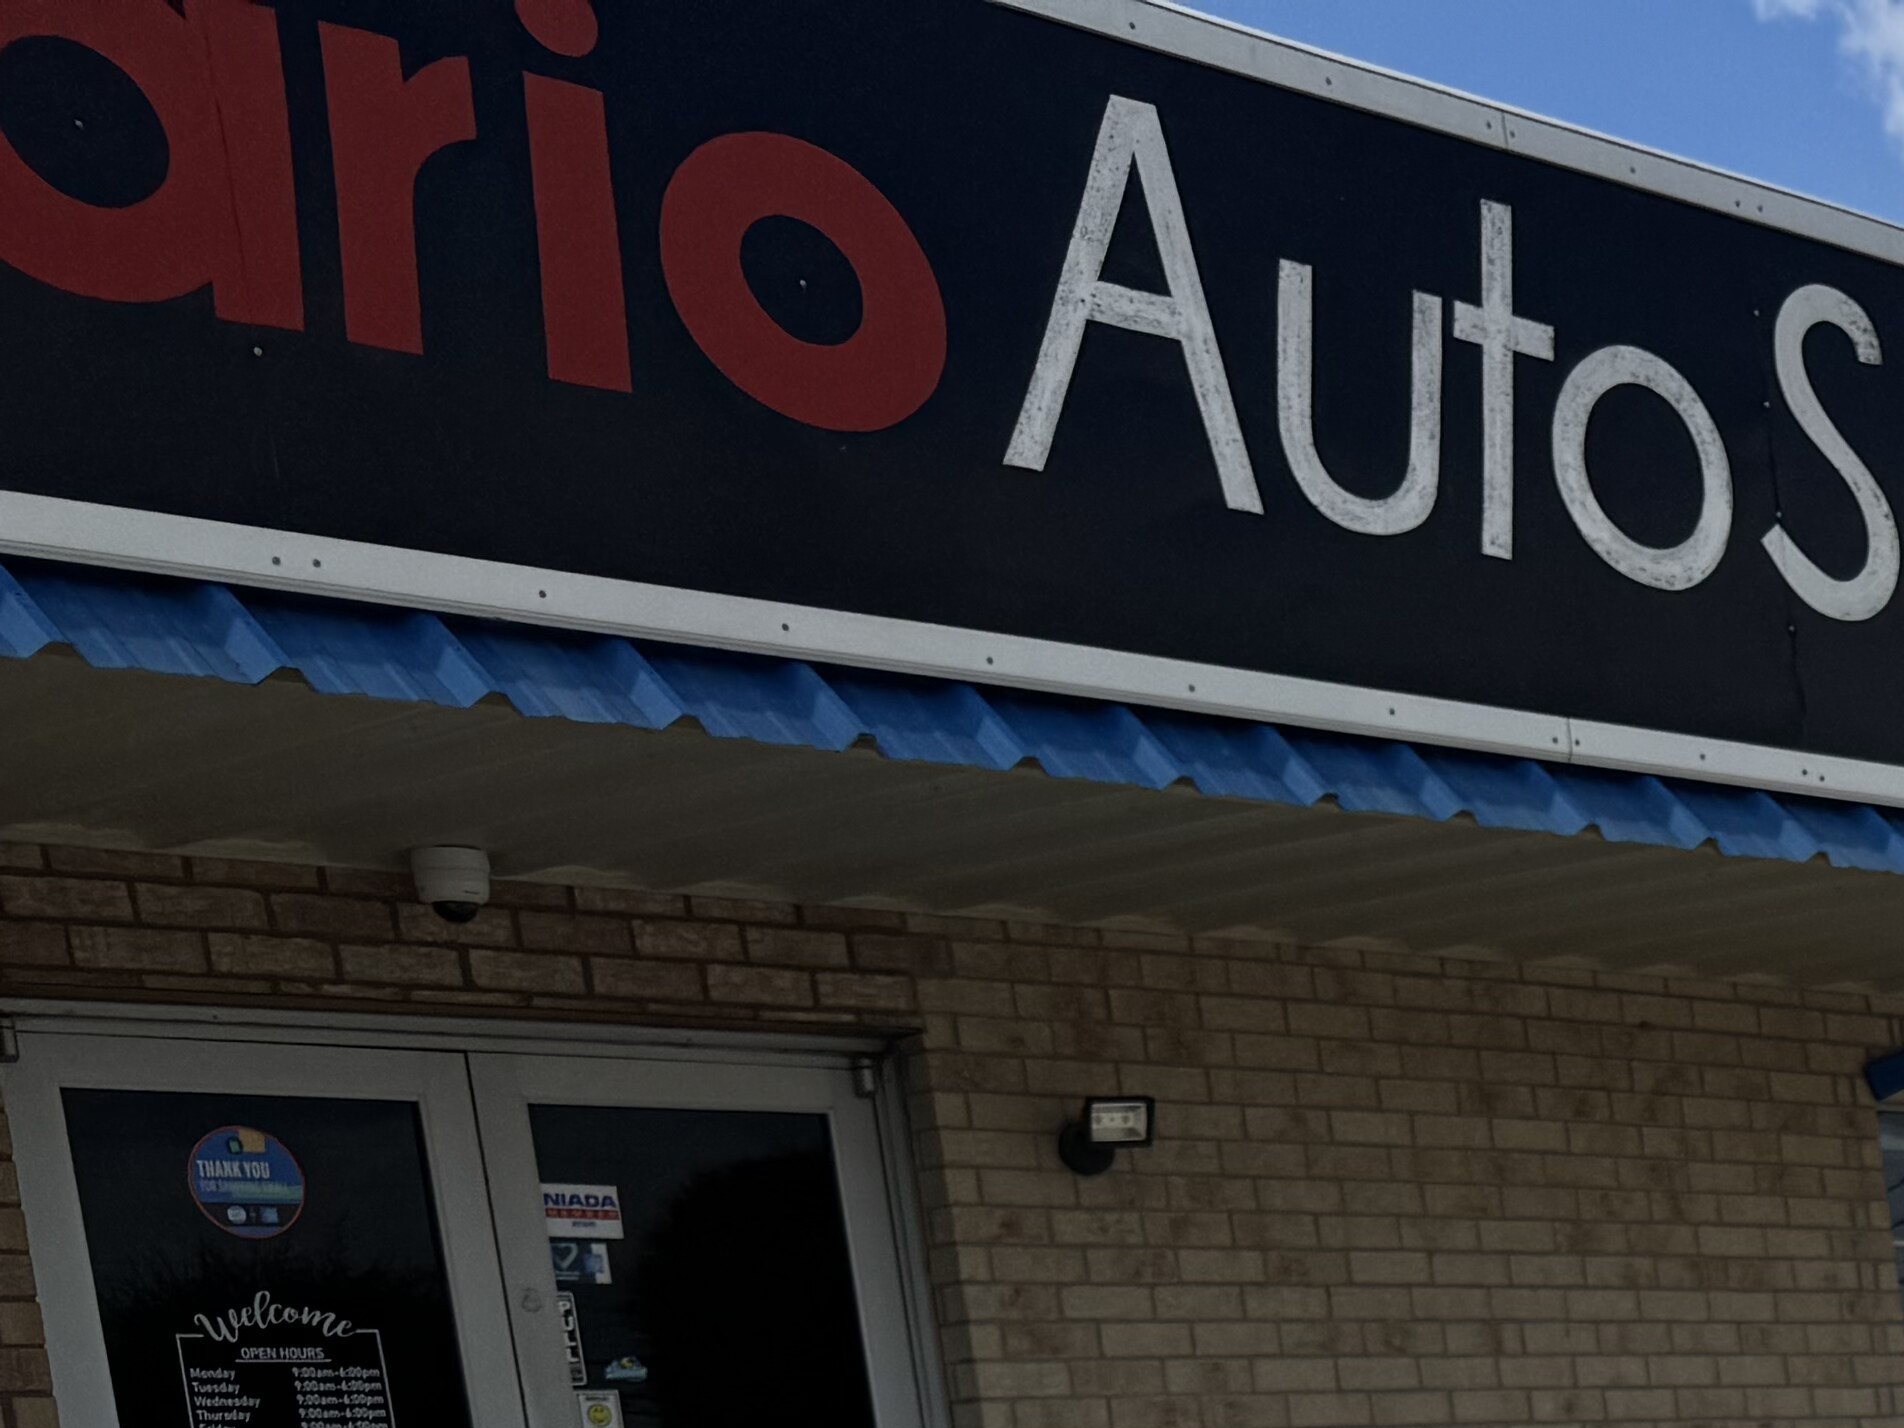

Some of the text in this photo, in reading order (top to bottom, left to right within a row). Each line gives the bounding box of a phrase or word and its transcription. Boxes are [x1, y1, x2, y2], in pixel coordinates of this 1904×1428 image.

[1002, 94, 1734, 590] Auto
[196, 1160, 271, 1179] THANK YOU
[543, 1193, 617, 1208] NIADA
[193, 1290, 356, 1343] Welcome
[557, 1300, 580, 1363] PULL
[240, 1346, 326, 1359] OPEN HOURS
[190, 1367, 236, 1380] Monday
[191, 1381, 240, 1394] Tuesday
[193, 1395, 261, 1408] Wednesday
[195, 1409, 251, 1423] Thursday
